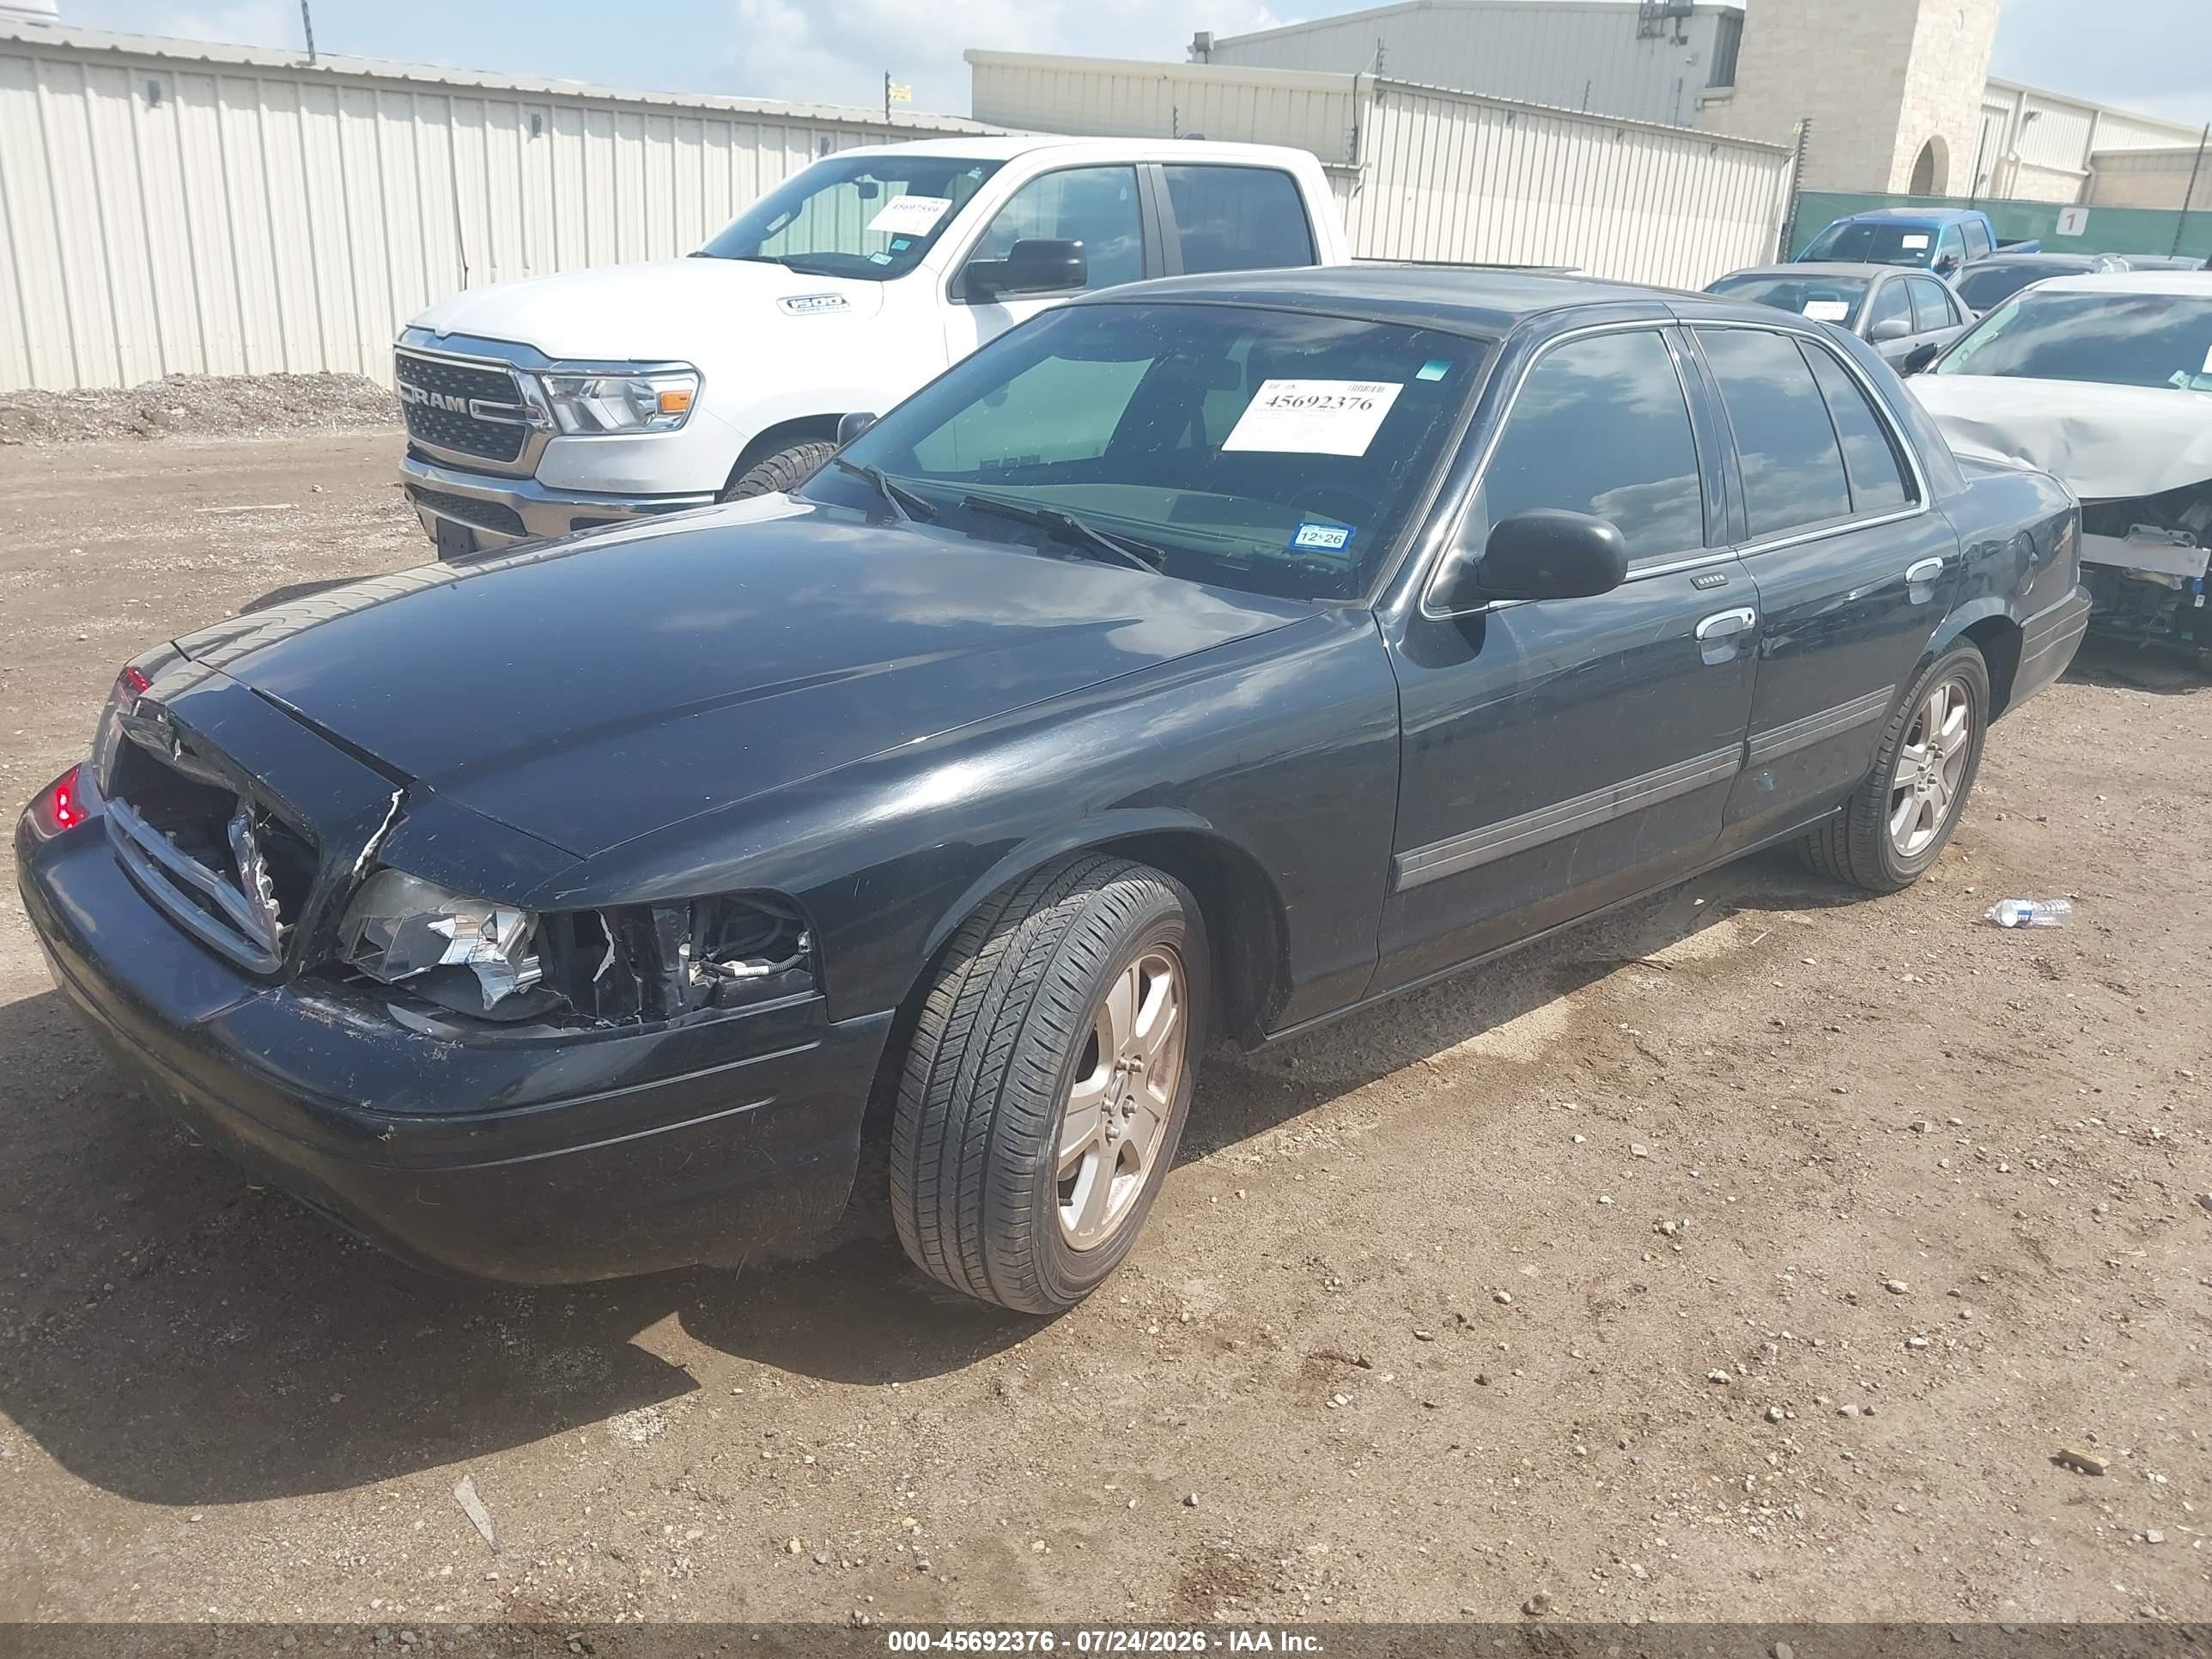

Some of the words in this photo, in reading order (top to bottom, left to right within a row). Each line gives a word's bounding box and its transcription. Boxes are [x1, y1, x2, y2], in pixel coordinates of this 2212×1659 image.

[2067, 212, 2076, 231] 1
[413, 387, 468, 414] RAM
[1265, 394, 1376, 411] 45692376
